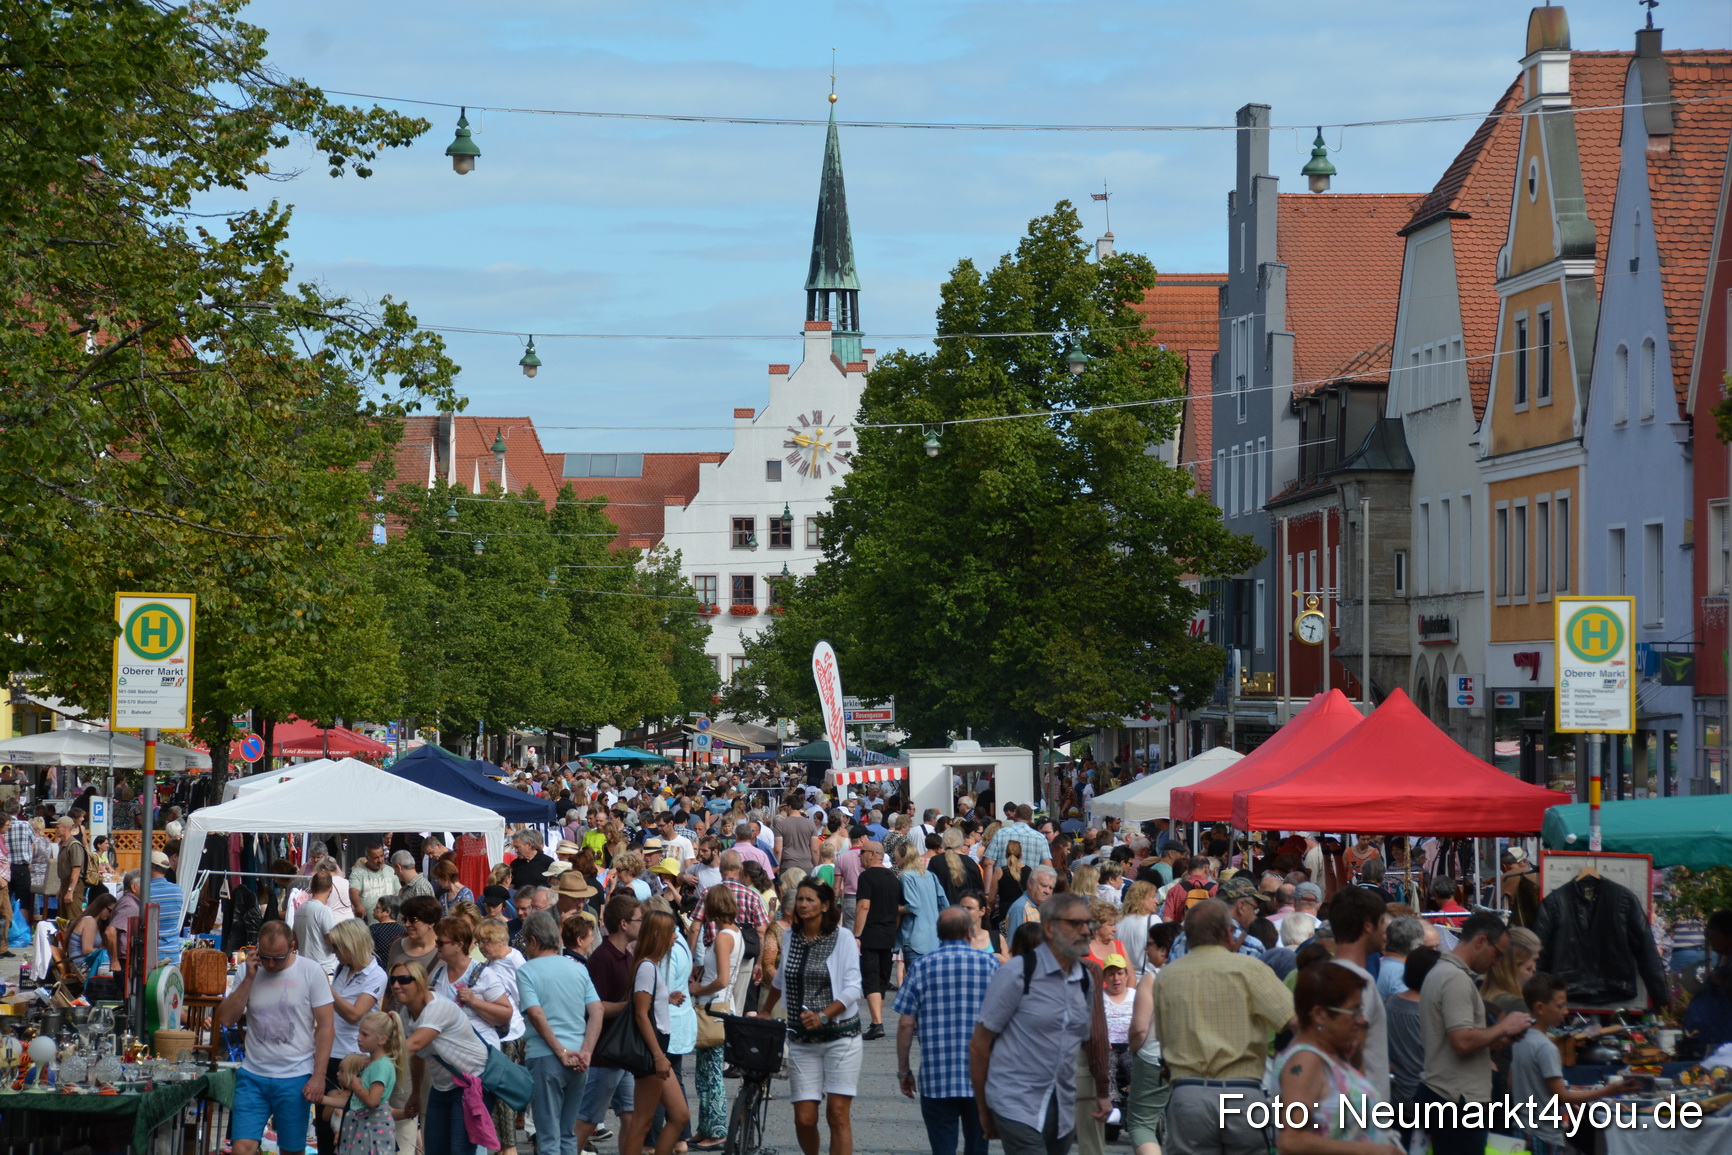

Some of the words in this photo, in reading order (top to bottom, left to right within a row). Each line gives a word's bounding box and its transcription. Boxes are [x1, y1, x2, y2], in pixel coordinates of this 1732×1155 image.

[141, 616, 168, 647] H
[1582, 619, 1609, 650] H
[122, 666, 154, 675] Oberer
[96, 804, 102, 814] P
